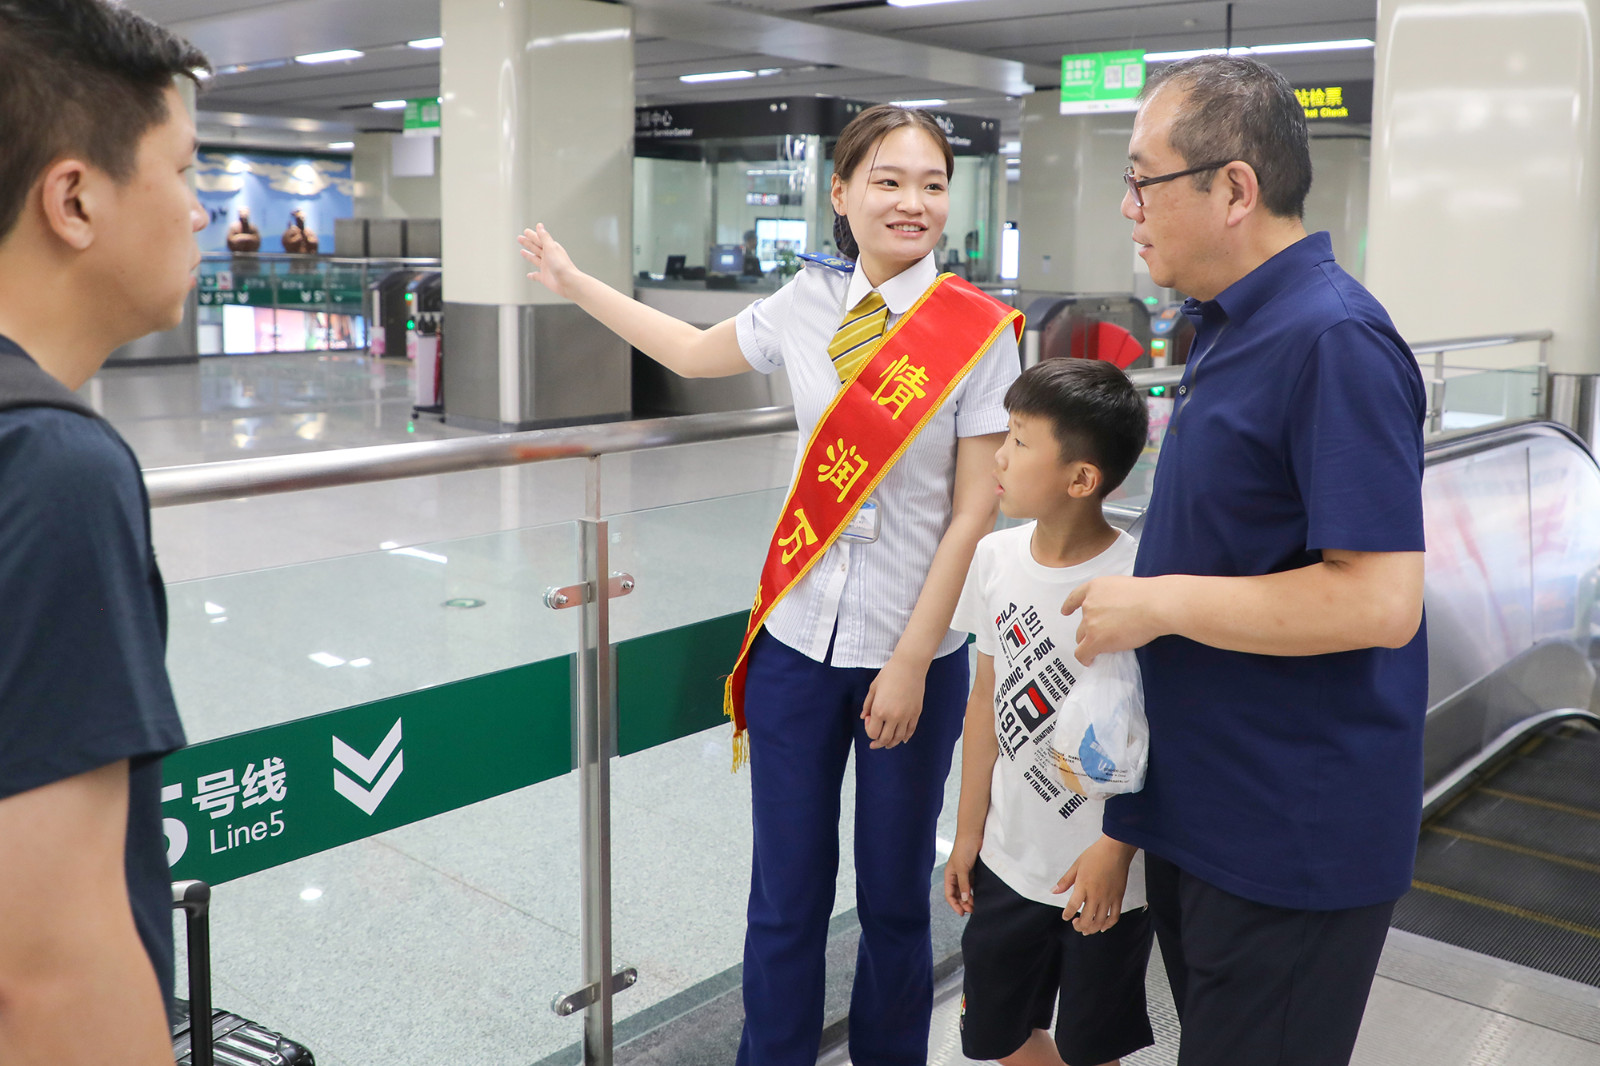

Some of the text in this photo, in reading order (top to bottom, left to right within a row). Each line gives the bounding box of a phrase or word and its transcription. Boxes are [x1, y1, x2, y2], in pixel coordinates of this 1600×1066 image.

[1320, 107, 1349, 118] Check
[995, 602, 1018, 631] FILA
[1021, 605, 1044, 638] 1911
[1000, 666, 1024, 699] ICONIC
[1023, 636, 1056, 671] F-BOX
[1045, 664, 1055, 675] OF
[1052, 657, 1077, 686] SIGNATU
[1037, 671, 1063, 703] HERITAGE
[998, 701, 1030, 755] 1911
[1032, 723, 1055, 746] SIGNATURE
[998, 733, 1016, 762] ICONIC
[1023, 771, 1033, 781] OF
[1030, 779, 1052, 803] ITALIAN
[1030, 764, 1062, 799] SIGNATURE
